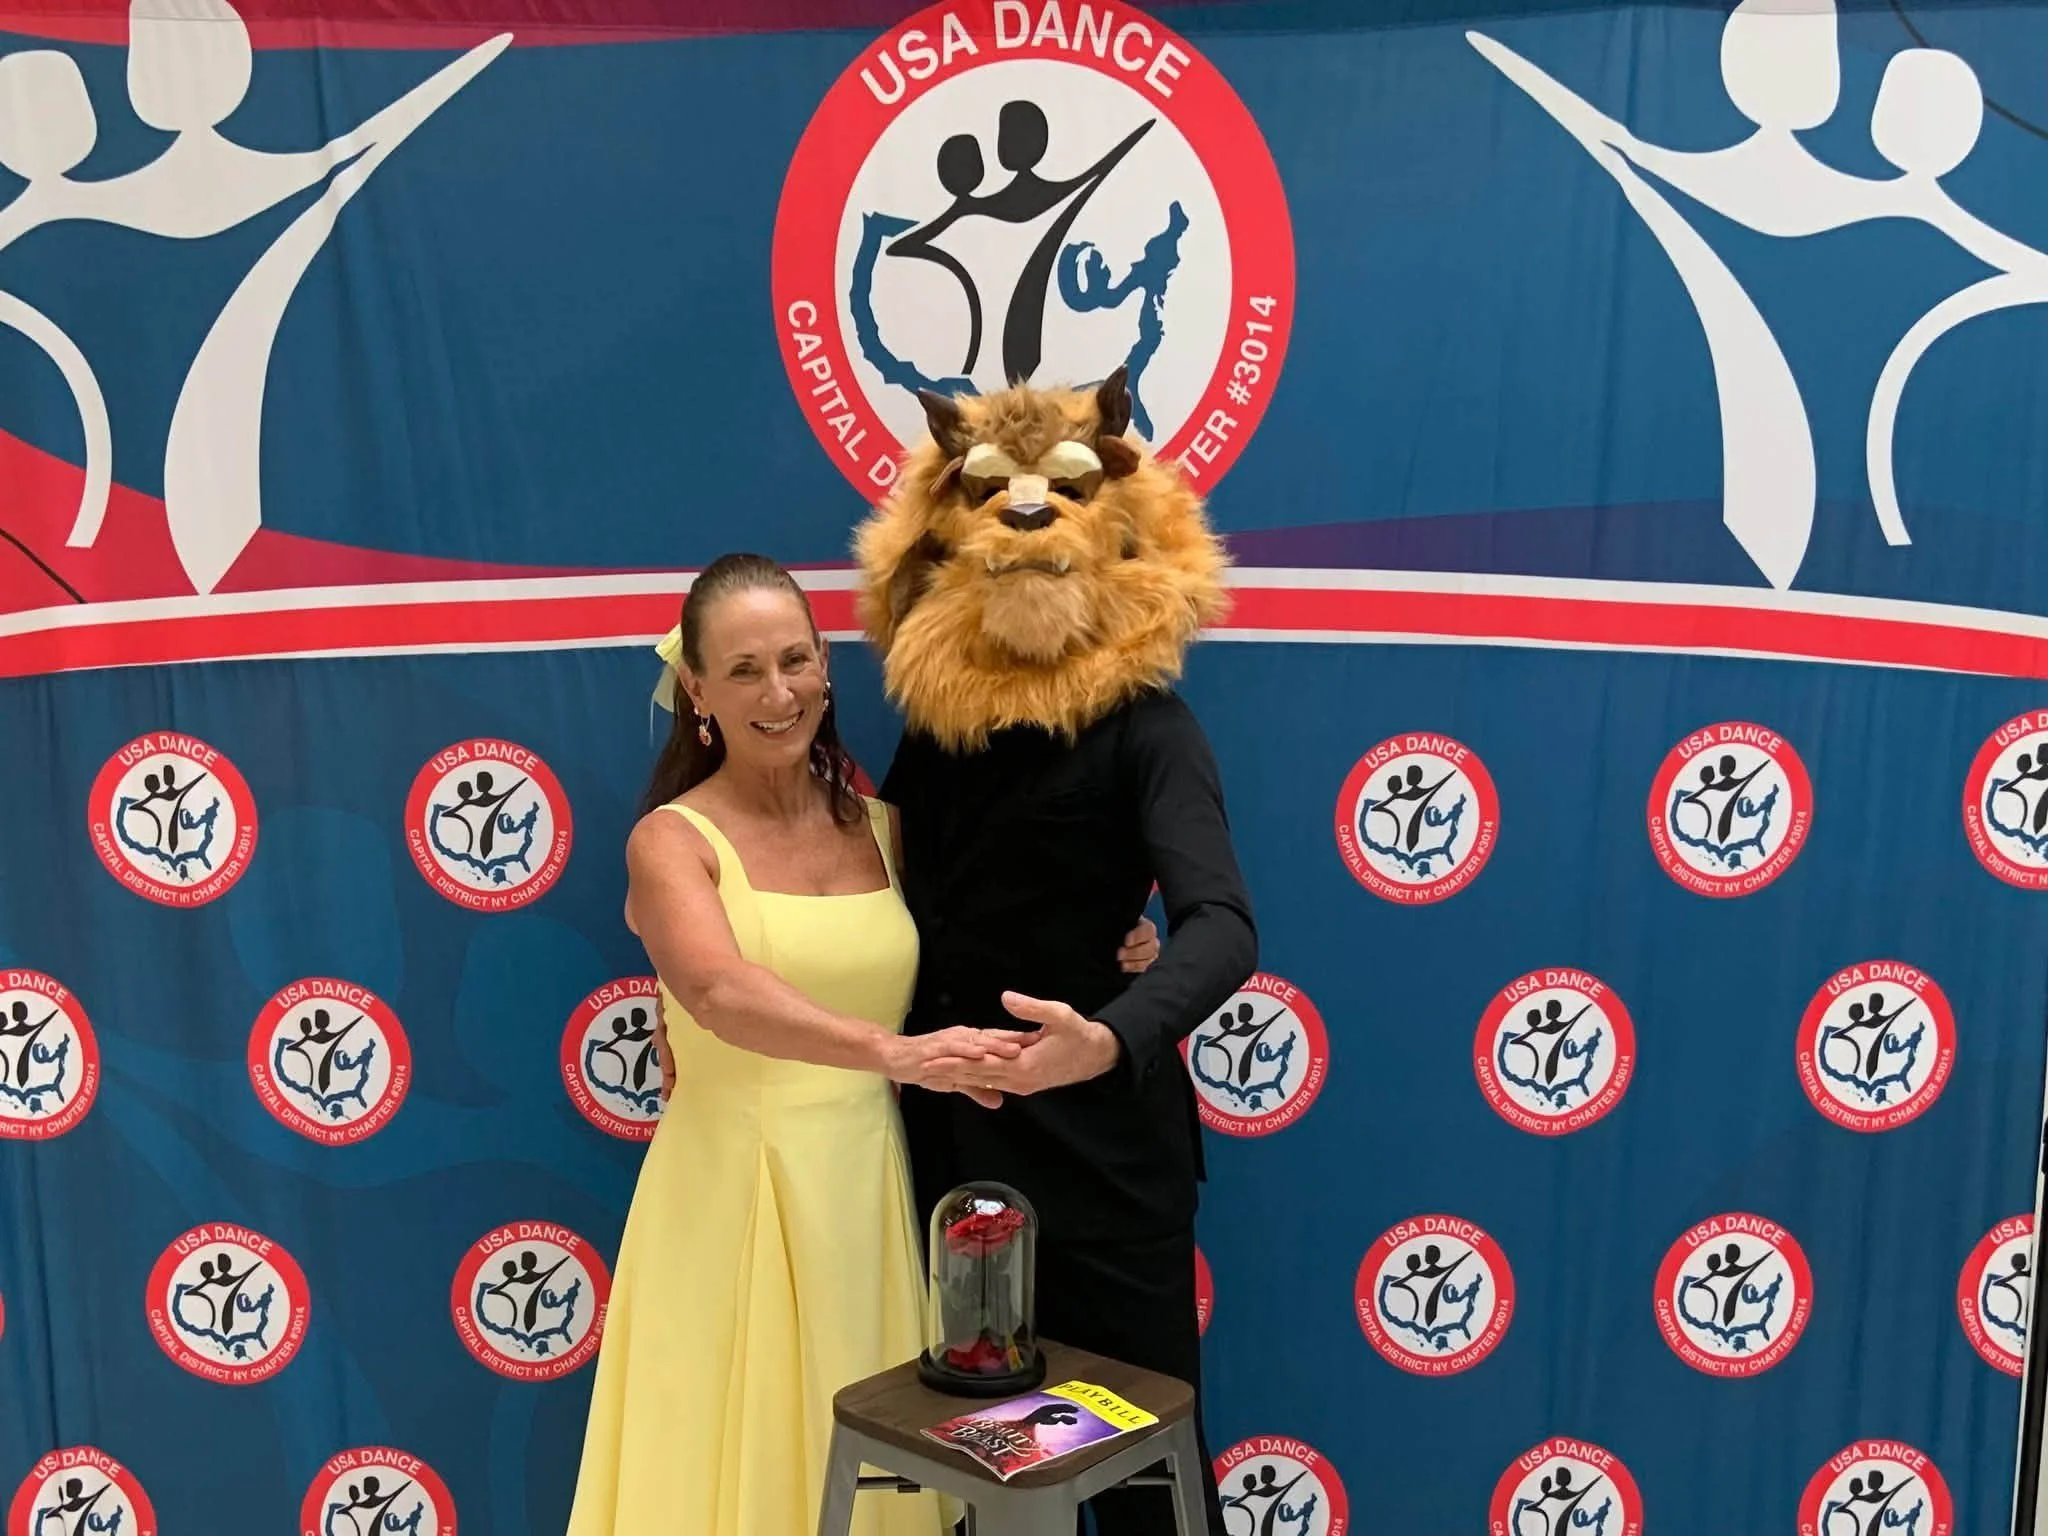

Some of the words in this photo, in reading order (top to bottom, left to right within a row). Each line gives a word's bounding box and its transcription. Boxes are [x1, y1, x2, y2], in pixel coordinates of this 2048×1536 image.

[859, 11, 980, 106] USA
[992, 0, 1192, 99] DANCE
[787, 299, 868, 463] CAPITAL
[1225, 294, 1278, 406] #3014
[1678, 730, 1715, 759] USA
[1720, 725, 1782, 753] DANCE
[1995, 717, 2033, 746] USA
[118, 738, 157, 766] USA
[159, 735, 218, 767] DANCE
[432, 746, 470, 773] USA
[474, 742, 538, 772] DANCE
[1365, 741, 1402, 769] USA
[1406, 736, 1469, 764] DANCE
[1651, 816, 1673, 865] CAPITAL
[1672, 863, 1722, 892] DISTRICT
[1724, 882, 1740, 892] NY
[1744, 846, 1792, 889] CHAPTER
[1967, 805, 1988, 856] CAPITAL
[1986, 852, 2036, 883] DISTRICT
[93, 823, 123, 873] CAPITAL
[123, 870, 179, 903] DISTRICT
[192, 860, 241, 901] CHAPTER
[410, 829, 436, 878] CAPITAL
[436, 876, 488, 906] DISTRICT
[491, 896, 507, 907] NY
[511, 864, 558, 903] CHAPTER
[1339, 824, 1362, 873] CAPITAL
[1361, 870, 1411, 899] DISTRICT
[1414, 889, 1430, 900] NY
[1434, 856, 1481, 896] CHAPTER
[8, 972, 68, 1004] DANCE
[276, 984, 309, 1008] USA
[312, 981, 375, 1010] DANCE
[1504, 976, 1542, 1002] USA
[1546, 972, 1604, 998] DANCE
[1827, 968, 1865, 995] USA
[1870, 964, 1929, 992] DANCE
[588, 984, 625, 1010] USA
[253, 1064, 280, 1111] CAPITAL
[281, 1108, 327, 1139] DISTRICT
[329, 1131, 345, 1141] NY
[348, 1098, 395, 1138] CHAPTER
[566, 1064, 589, 1111] CAPITAL
[591, 1108, 639, 1136] DISTRICT
[1478, 1057, 1501, 1104] CAPITAL
[1500, 1102, 1549, 1131] DISTRICT
[1552, 1120, 1566, 1131] NY
[1569, 1088, 1617, 1126] CHAPTER
[1800, 1052, 1820, 1100] CAPITAL
[1820, 1097, 1869, 1127] DISTRICT
[1888, 1083, 1938, 1123] CHAPTER
[46, 1095, 88, 1133] CHAPTER
[1247, 1122, 1262, 1132] NY
[1265, 1090, 1311, 1128] CHAPTER
[174, 1228, 212, 1255] USA
[214, 1226, 273, 1256] DANCE
[478, 1229, 515, 1254] USA
[519, 1224, 580, 1250] DANCE
[1384, 1222, 1420, 1247] USA
[1424, 1218, 1484, 1245] DANCE
[1685, 1220, 1722, 1247] USA
[1726, 1216, 1786, 1245] DANCE
[1990, 1219, 2028, 1244] USA
[151, 1309, 178, 1354] CAPITAL
[179, 1352, 230, 1379] DISTRICT
[233, 1370, 247, 1380] NY
[250, 1341, 294, 1378] CHAPTER
[456, 1307, 481, 1352] CAPITAL
[481, 1349, 531, 1376] DISTRICT
[534, 1366, 549, 1376] NY
[553, 1336, 597, 1373] CHAPTER
[1359, 1298, 1382, 1344] CAPITAL
[1382, 1342, 1430, 1371] DISTRICT
[1433, 1362, 1448, 1371] NY
[1451, 1331, 1497, 1369] CHAPTER
[1658, 1299, 1681, 1346] CAPITAL
[1680, 1344, 1726, 1371] DISTRICT
[1730, 1363, 1746, 1373] NY
[1749, 1331, 1795, 1370] CHAPTER
[1962, 1298, 1982, 1344] CAPITAL
[1981, 1343, 2022, 1373] DISTRIC
[1058, 1382, 1142, 1425] PLAYBILL
[62, 1449, 121, 1478] DANCE
[328, 1454, 357, 1475] USA
[361, 1450, 422, 1475] DANCE
[1222, 1443, 1256, 1467] USA
[1260, 1439, 1319, 1465] DANCE
[1520, 1445, 1552, 1471] USA
[1556, 1440, 1614, 1470] DANCE
[1830, 1446, 1864, 1473] USA
[1868, 1443, 1927, 1471] DANCE
